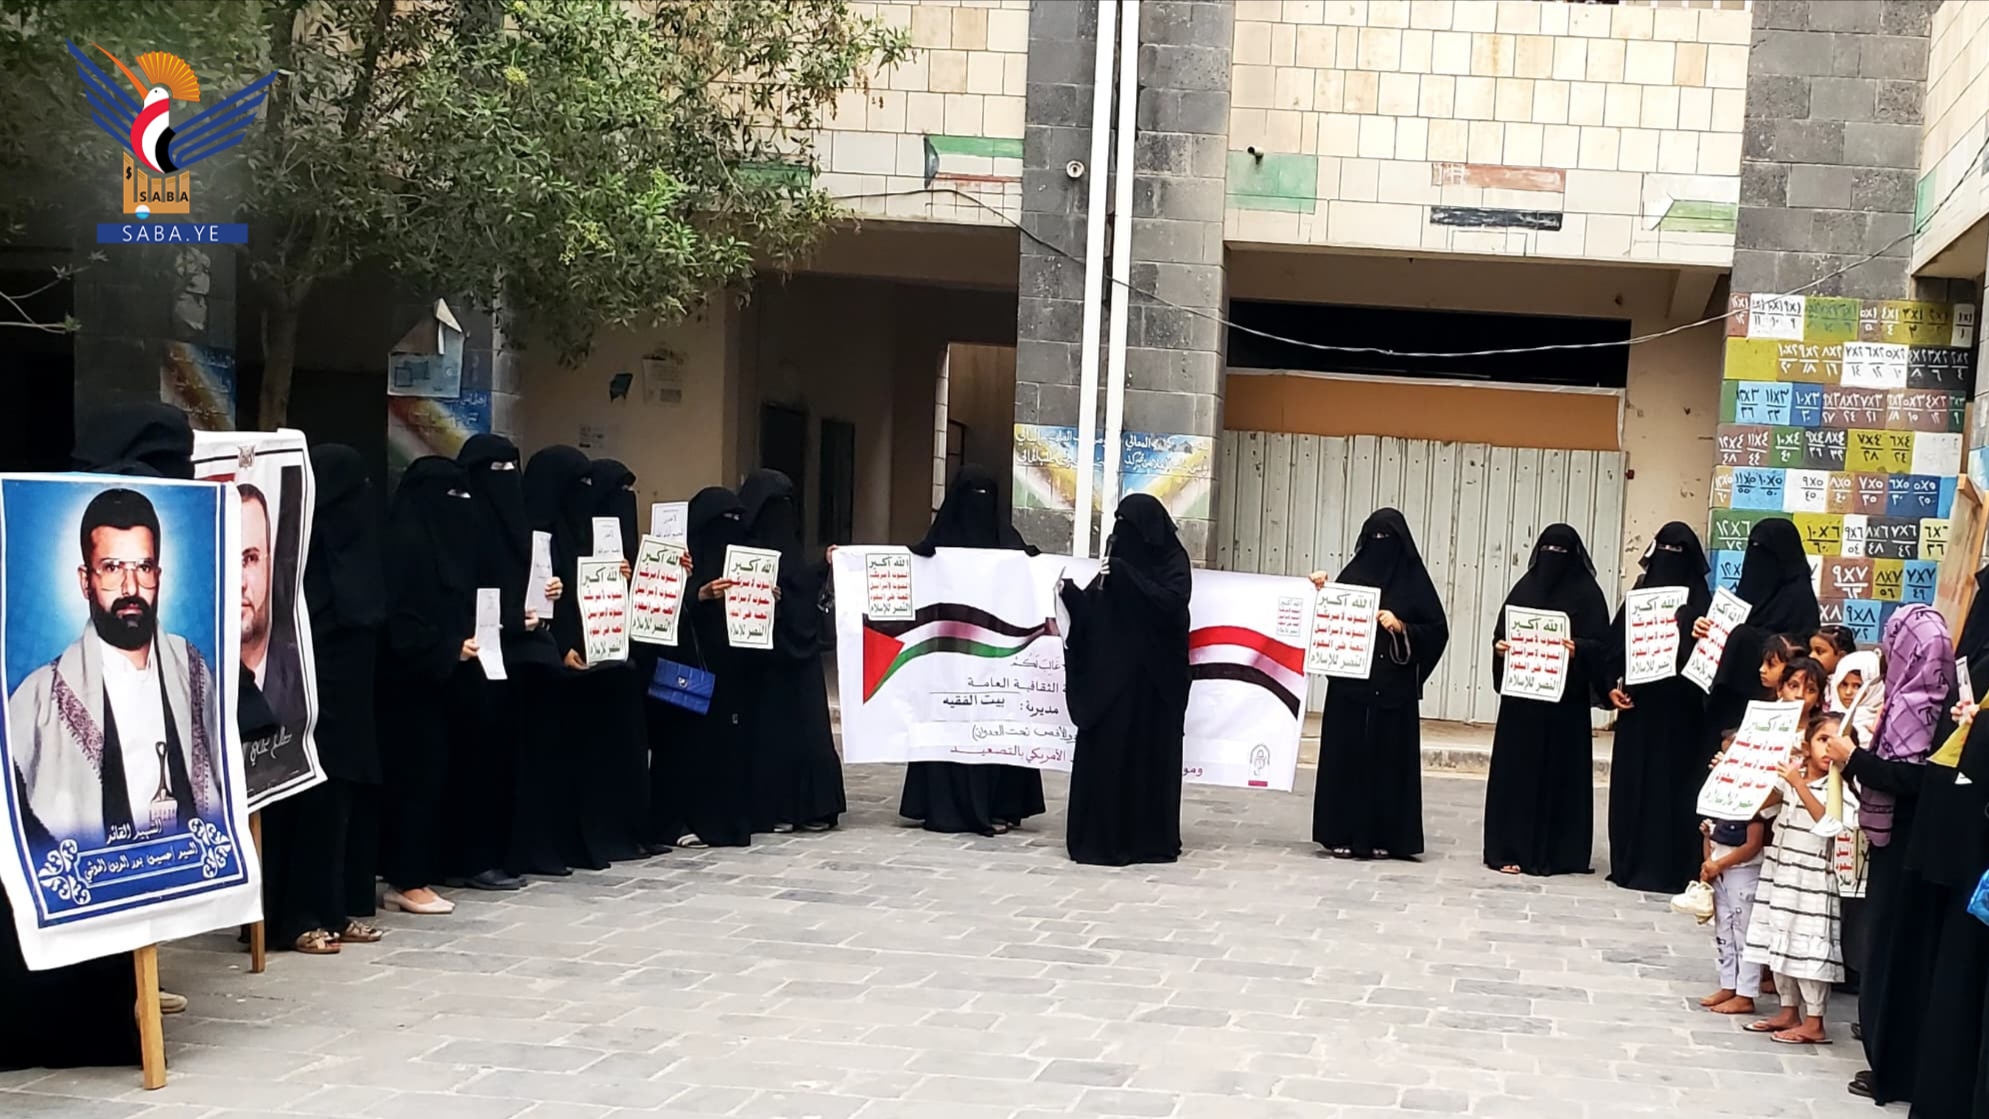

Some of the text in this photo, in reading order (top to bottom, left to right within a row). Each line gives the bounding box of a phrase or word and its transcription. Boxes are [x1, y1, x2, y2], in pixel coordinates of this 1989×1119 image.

[667, 551, 679, 565] لله
[1014, 678, 1059, 693] الثقافية
[943, 694, 977, 709] الفقيه
[981, 695, 1005, 707] بيت
